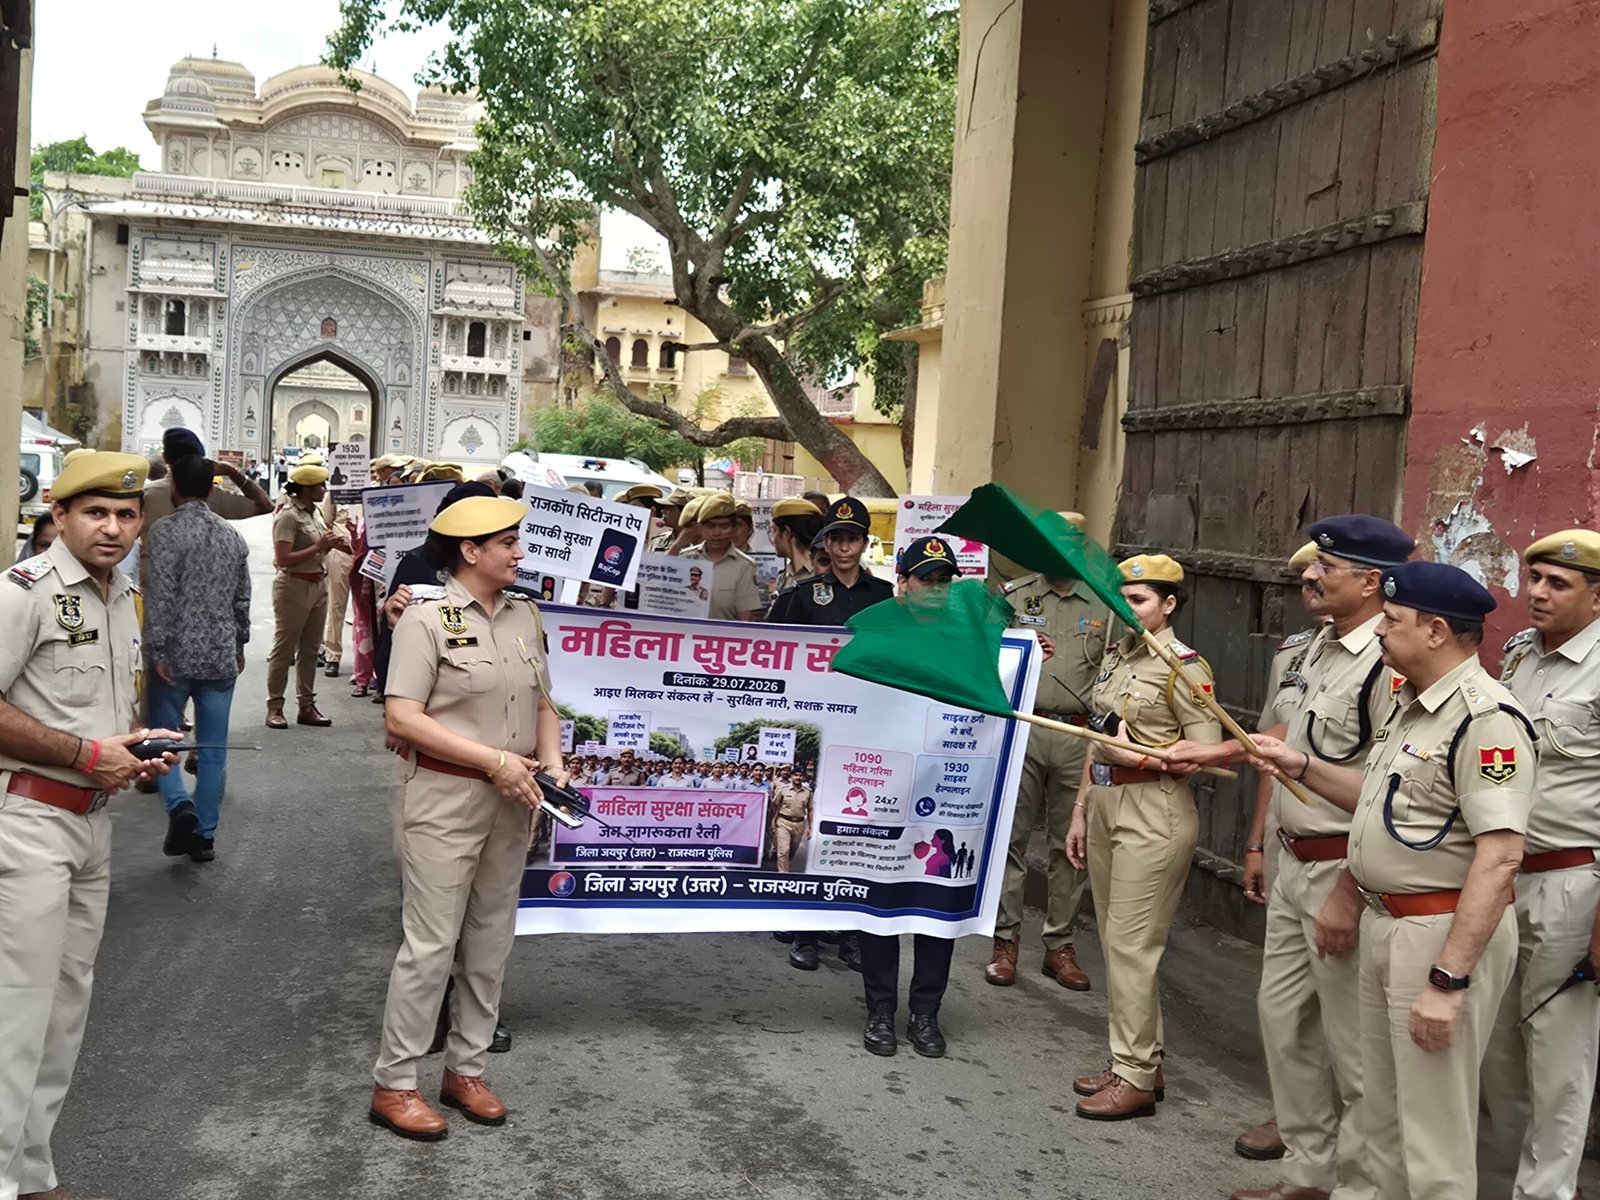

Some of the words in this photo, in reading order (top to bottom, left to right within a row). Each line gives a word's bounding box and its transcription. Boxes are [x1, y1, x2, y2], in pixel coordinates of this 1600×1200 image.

[342, 444, 360, 453] 1930
[530, 495, 575, 517] राजकॉप
[576, 502, 623, 528] सिटीजन
[625, 513, 643, 532] ऐप
[918, 501, 943, 513] महिला
[525, 522, 563, 541] आपकी
[563, 530, 594, 547] सुरक्षा
[528, 541, 542, 556] का
[544, 545, 572, 562] साथी
[597, 562, 621, 577] RajCop
[559, 620, 685, 662] महिला
[692, 634, 799, 674] सुरक्षा
[806, 637, 843, 673] सं
[673, 673, 710, 687] दिनांक:
[713, 677, 779, 692] 29.07.2026
[593, 687, 622, 699] आइए
[625, 686, 664, 701] मिलकर
[667, 689, 701, 702] संकल्प
[703, 691, 714, 703] लें
[726, 694, 763, 708] सुरक्षित
[766, 696, 791, 711] नारी,
[794, 700, 824, 712] सशक्त
[827, 703, 858, 715] समाज
[942, 713, 969, 723] साइबर
[950, 726, 958, 735] से
[855, 752, 882, 764] 1090
[843, 763, 868, 774] महिला
[870, 765, 893, 776] गरिमा
[944, 762, 969, 773] 1930
[848, 774, 885, 788] हेल्पलाइन
[943, 774, 967, 783] साइबर
[935, 783, 971, 795] हेल्पलाइन
[875, 795, 898, 805] 24x7
[597, 795, 647, 817] महिला
[651, 801, 695, 822] सुरक्षा
[697, 799, 747, 819] संकल्प
[625, 825, 692, 840] जागरूकता
[696, 822, 722, 840] रैली
[836, 825, 860, 835] हमारा
[861, 826, 890, 837] संकल्प
[575, 846, 599, 858] जिला
[601, 848, 628, 861] जयपुर
[630, 847, 656, 859] (उत्तर)
[667, 848, 705, 859] राजस्थान
[707, 847, 734, 861] पुलिस
[584, 872, 626, 893] जिला
[629, 877, 679, 899] जयपुर
[682, 875, 727, 896] (उत्तर)
[749, 878, 819, 895] राजस्थान
[823, 879, 869, 901] पुलिस
